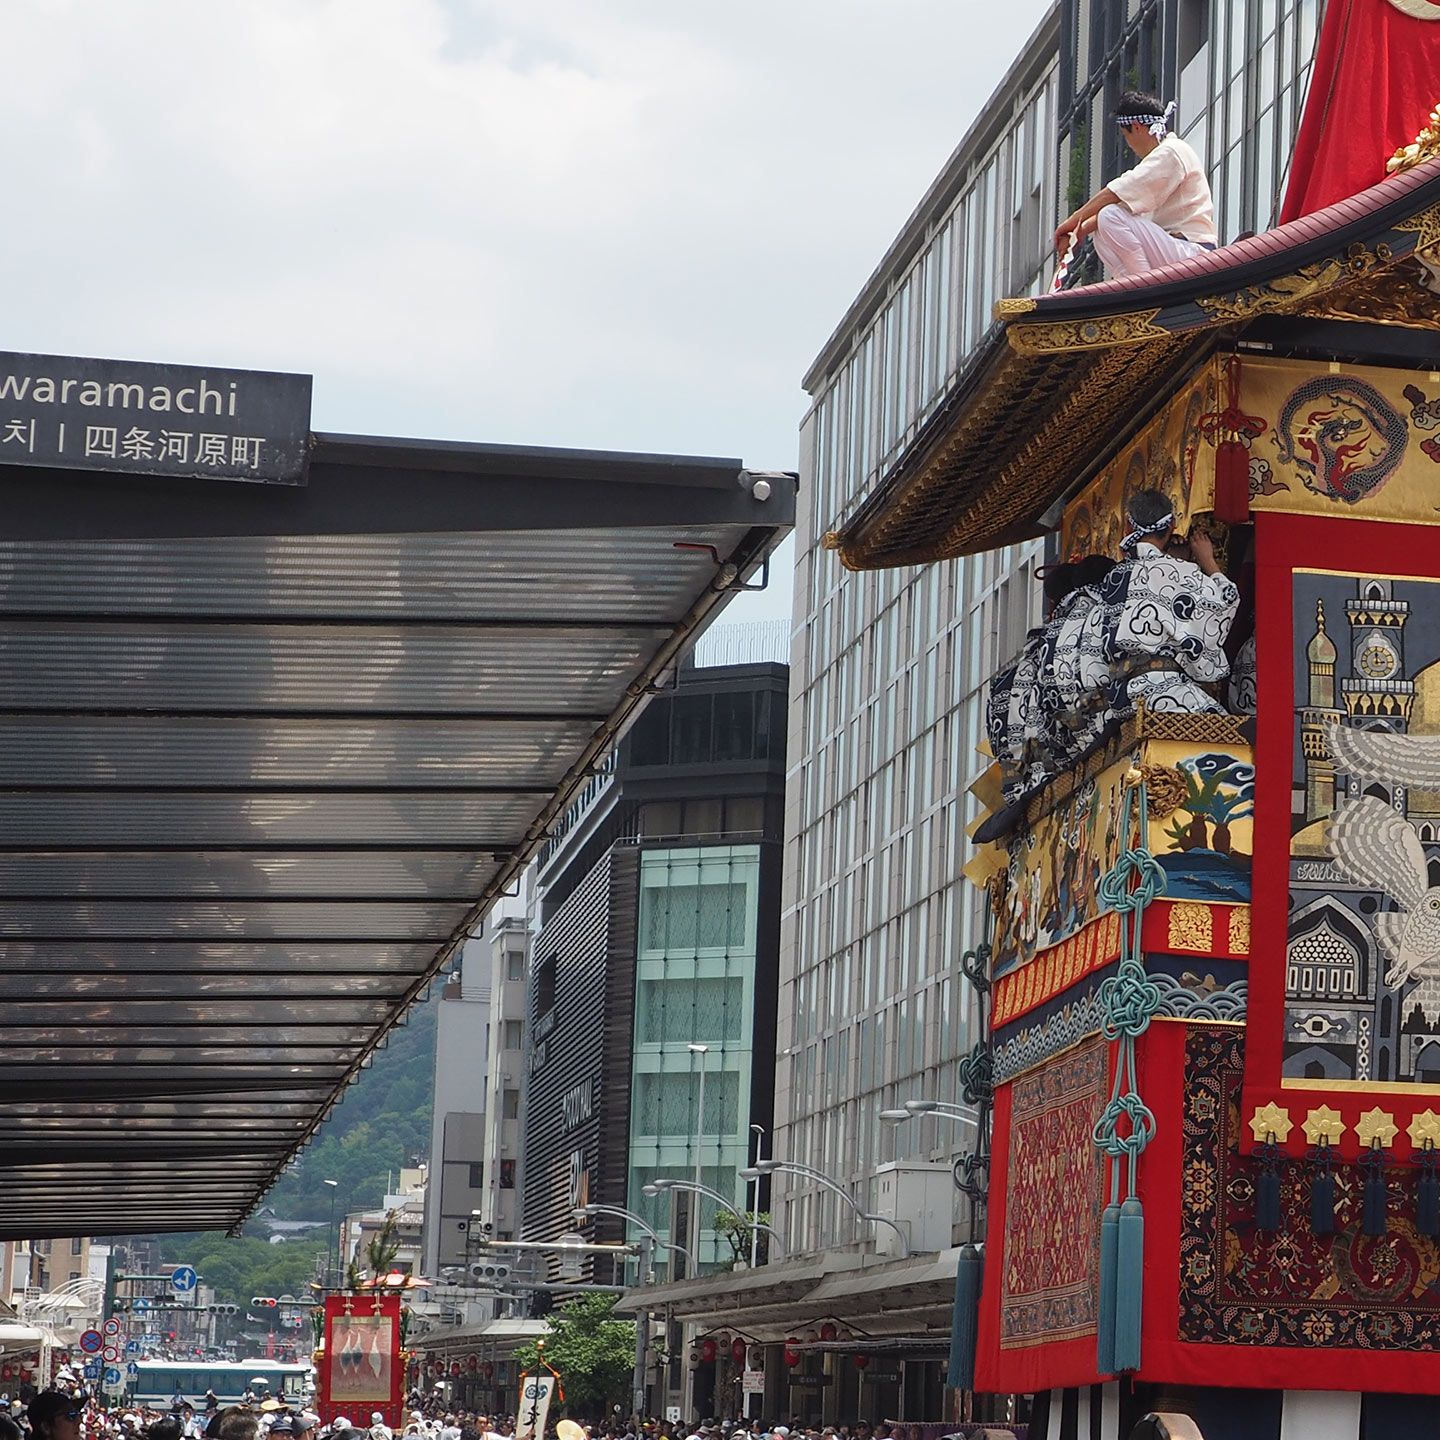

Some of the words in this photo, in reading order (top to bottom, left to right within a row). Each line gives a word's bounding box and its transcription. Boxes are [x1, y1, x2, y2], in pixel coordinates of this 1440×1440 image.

[84, 425, 267, 469] 四条河原町
